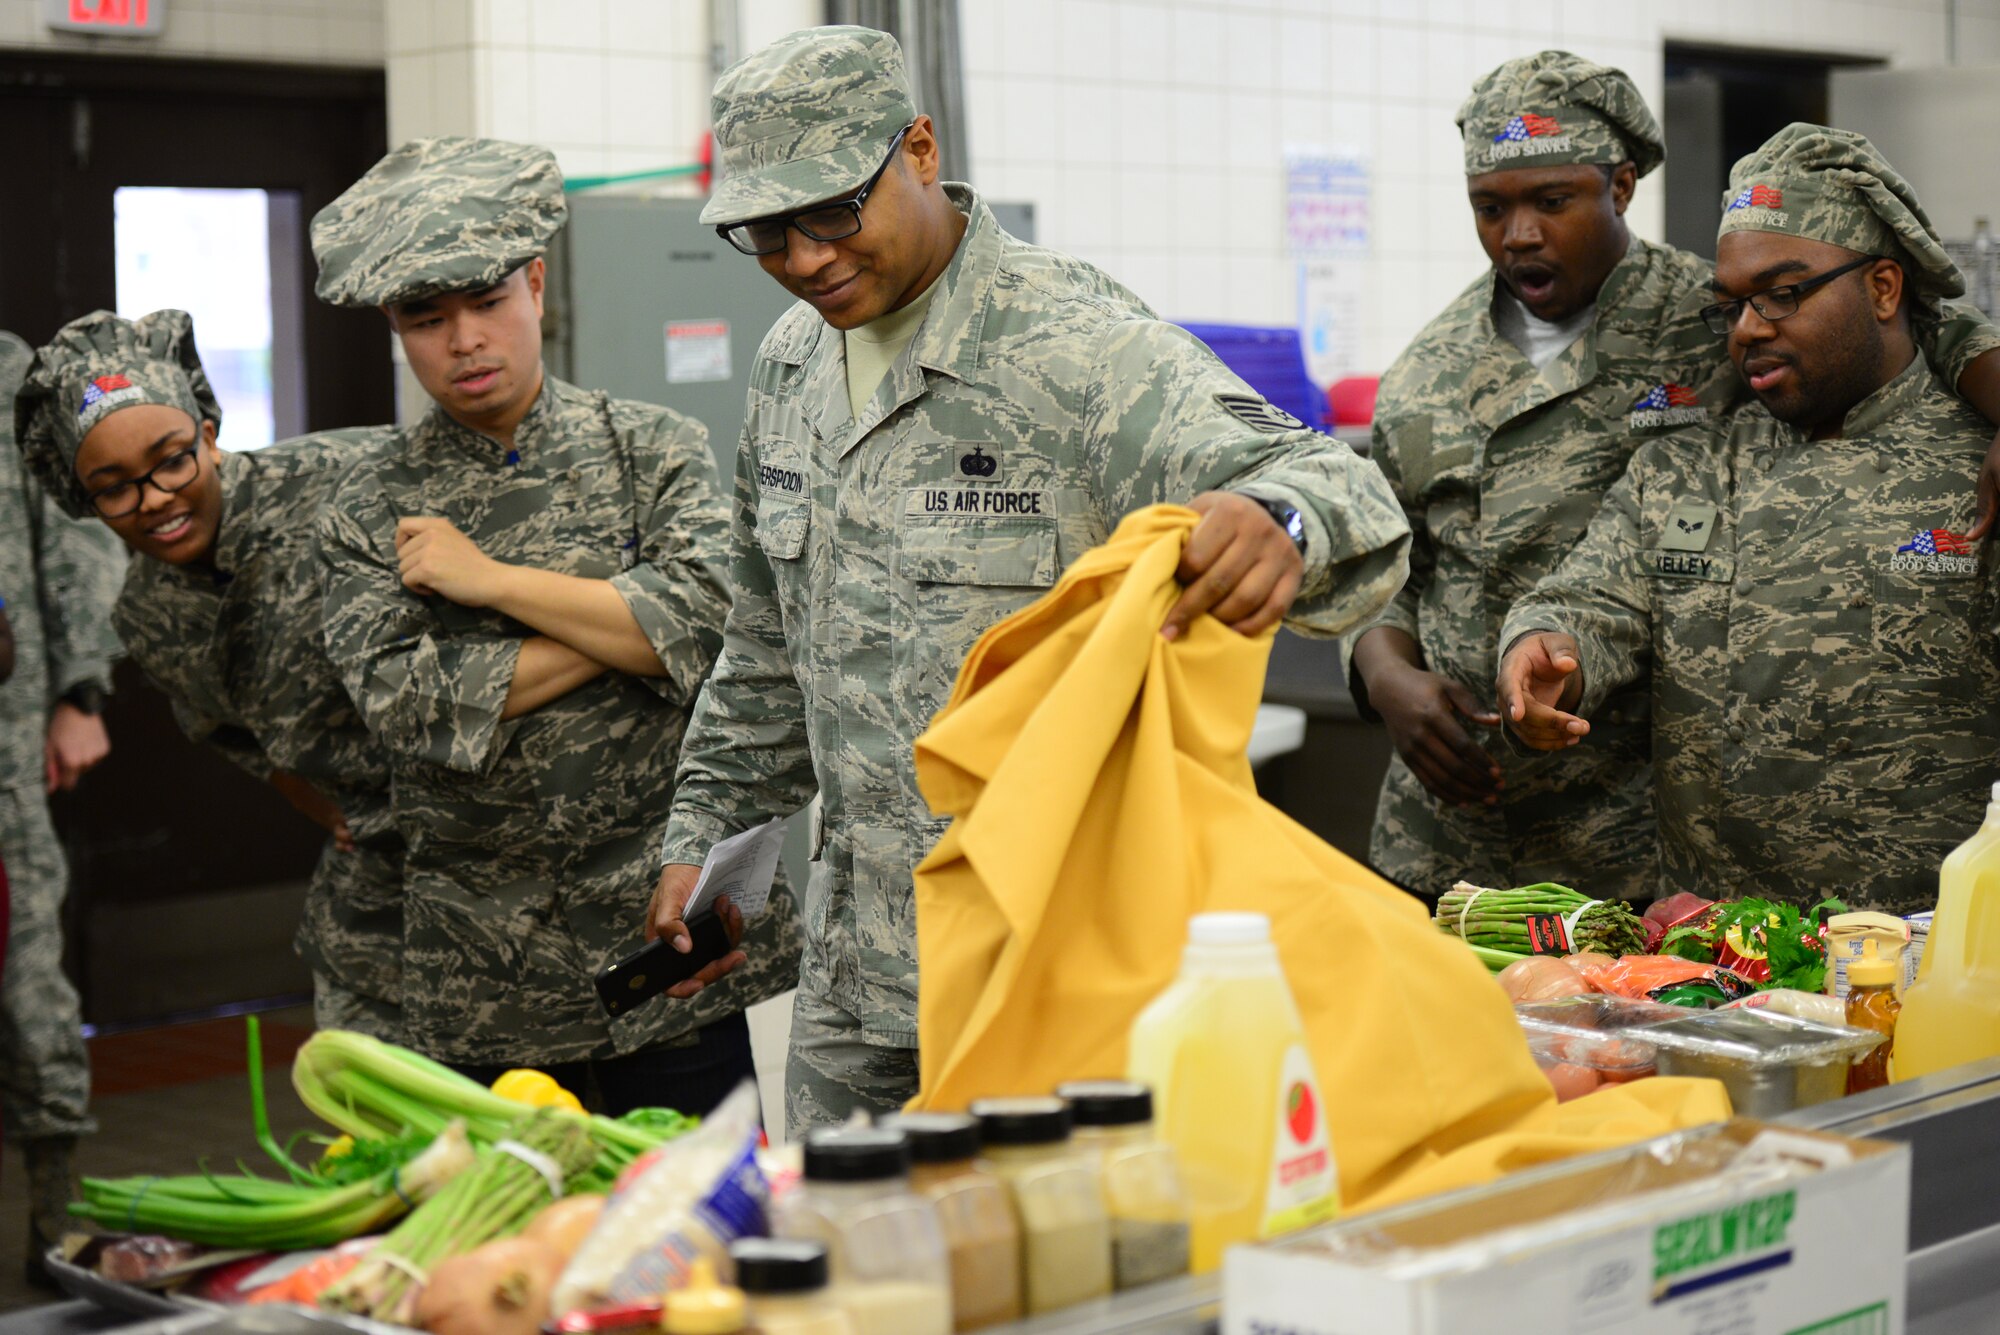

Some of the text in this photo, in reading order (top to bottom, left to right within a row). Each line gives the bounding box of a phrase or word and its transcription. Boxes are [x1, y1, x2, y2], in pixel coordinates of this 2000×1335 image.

[760, 464, 803, 493] ERSPOON
[925, 491, 1041, 513] U.S. AIR FORCE
[1656, 555, 1712, 576] KELLEY
[1890, 561, 1977, 574] FOOD SERVICE
